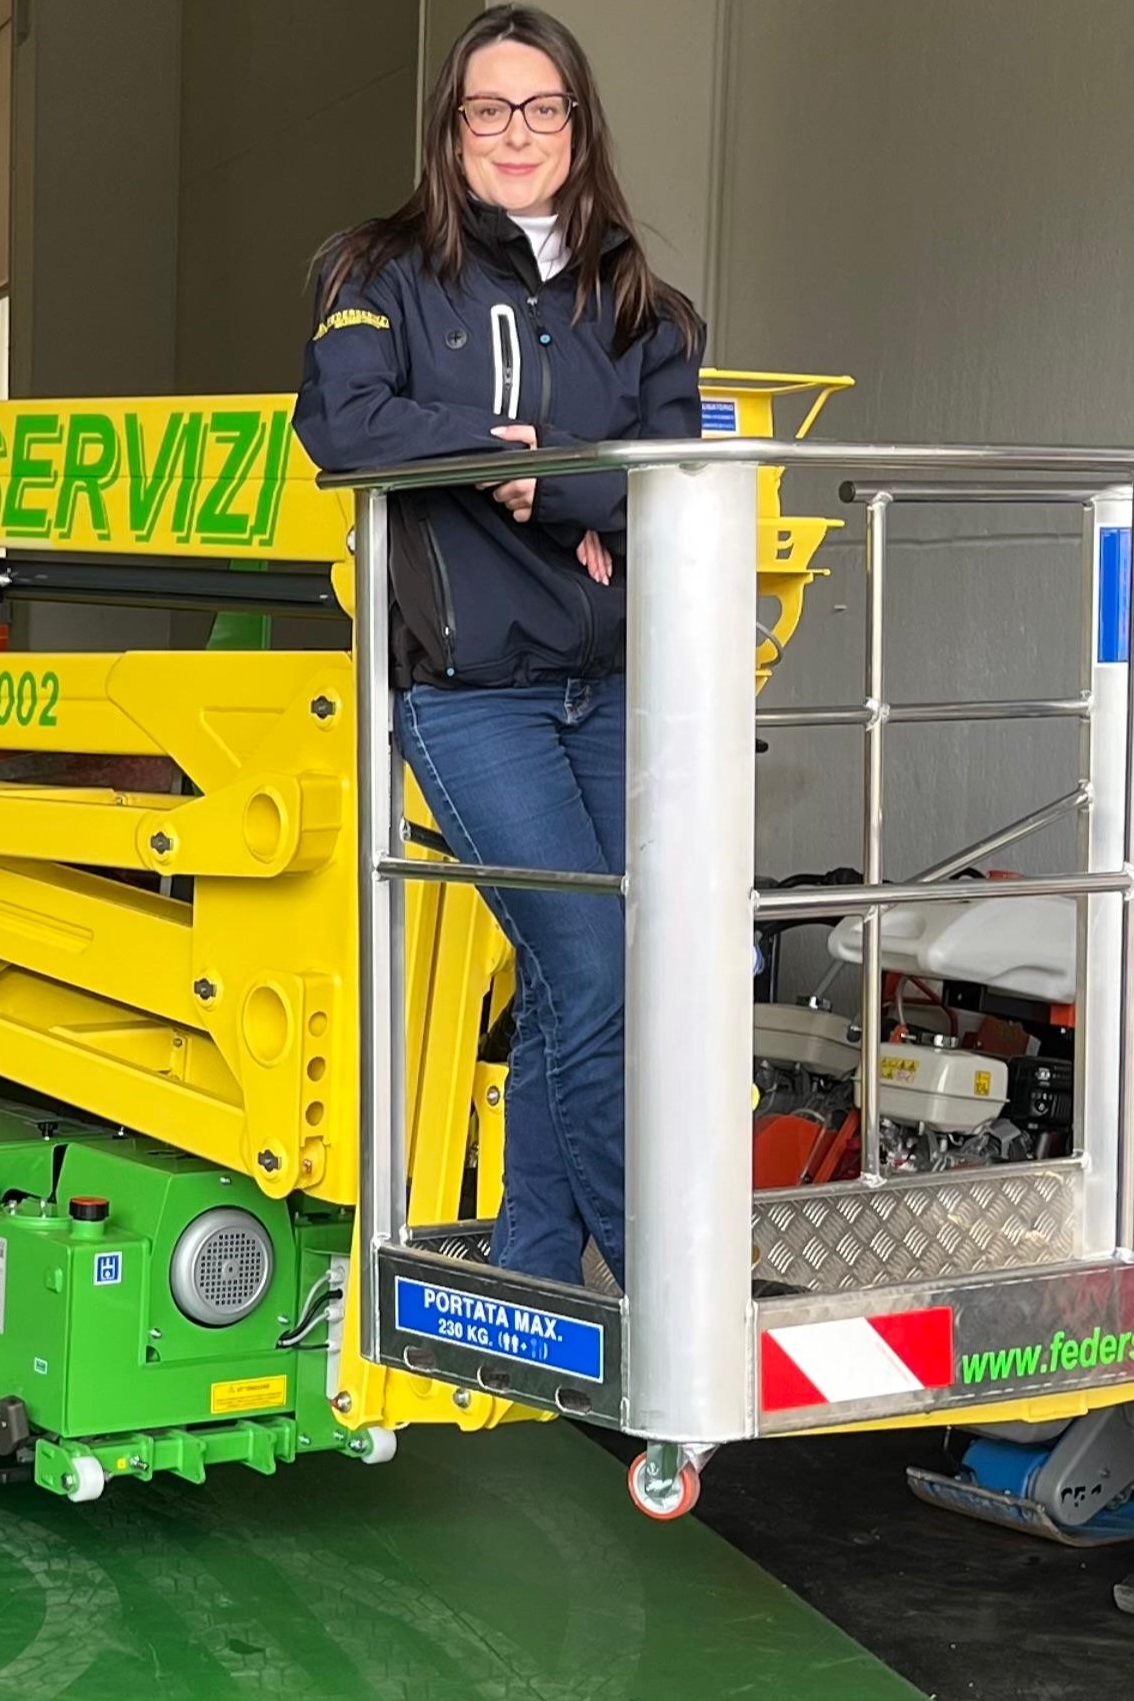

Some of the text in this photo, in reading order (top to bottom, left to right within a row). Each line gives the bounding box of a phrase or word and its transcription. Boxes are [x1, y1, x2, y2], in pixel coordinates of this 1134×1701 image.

[423, 1287, 564, 1342] PORTATA MAX.
[438, 1317, 494, 1347] 230 KG.
[961, 1326, 1134, 1384] www.feder
